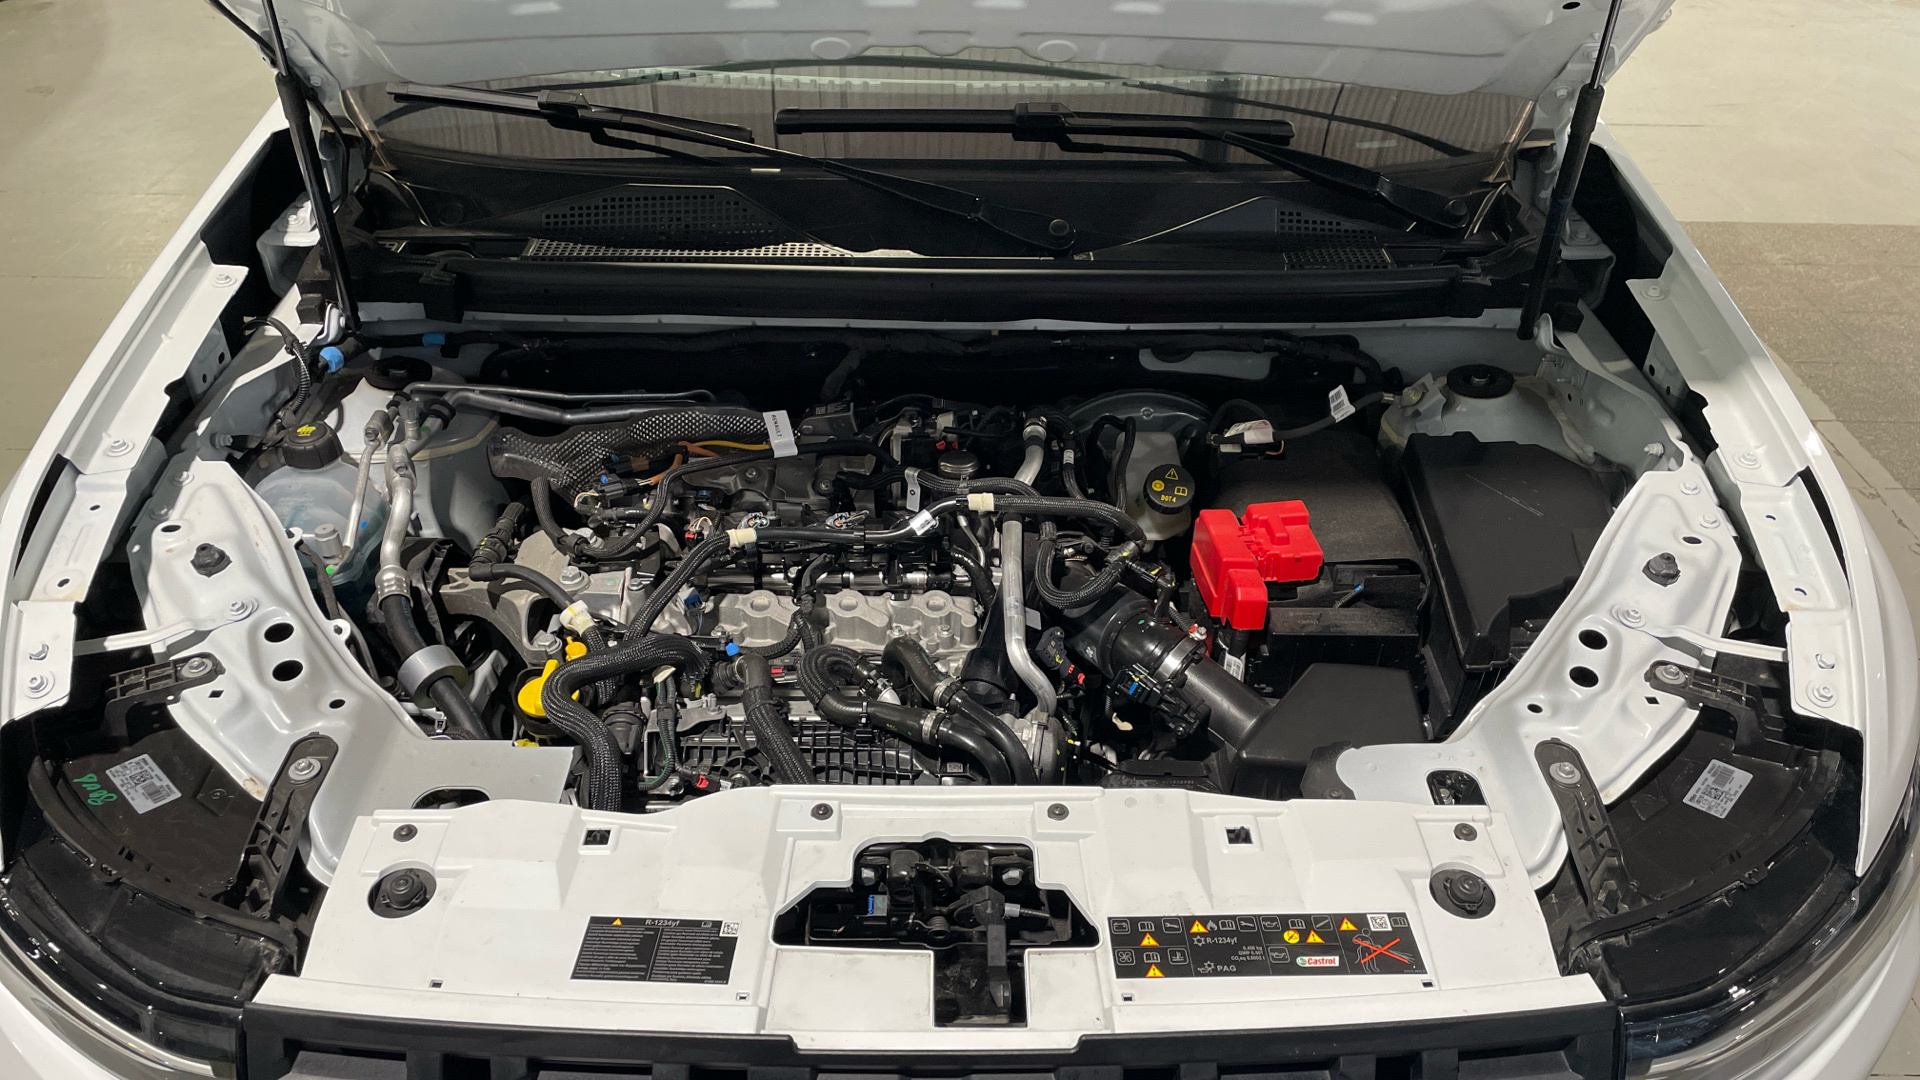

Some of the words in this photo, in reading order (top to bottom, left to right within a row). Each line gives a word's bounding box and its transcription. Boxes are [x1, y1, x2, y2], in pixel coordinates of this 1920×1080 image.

[771, 414, 782, 437] RENAULT
[645, 919, 680, 927] R-1234yf
[1206, 936, 1238, 945] R-1234yf
[1307, 957, 1337, 966] Castrol
